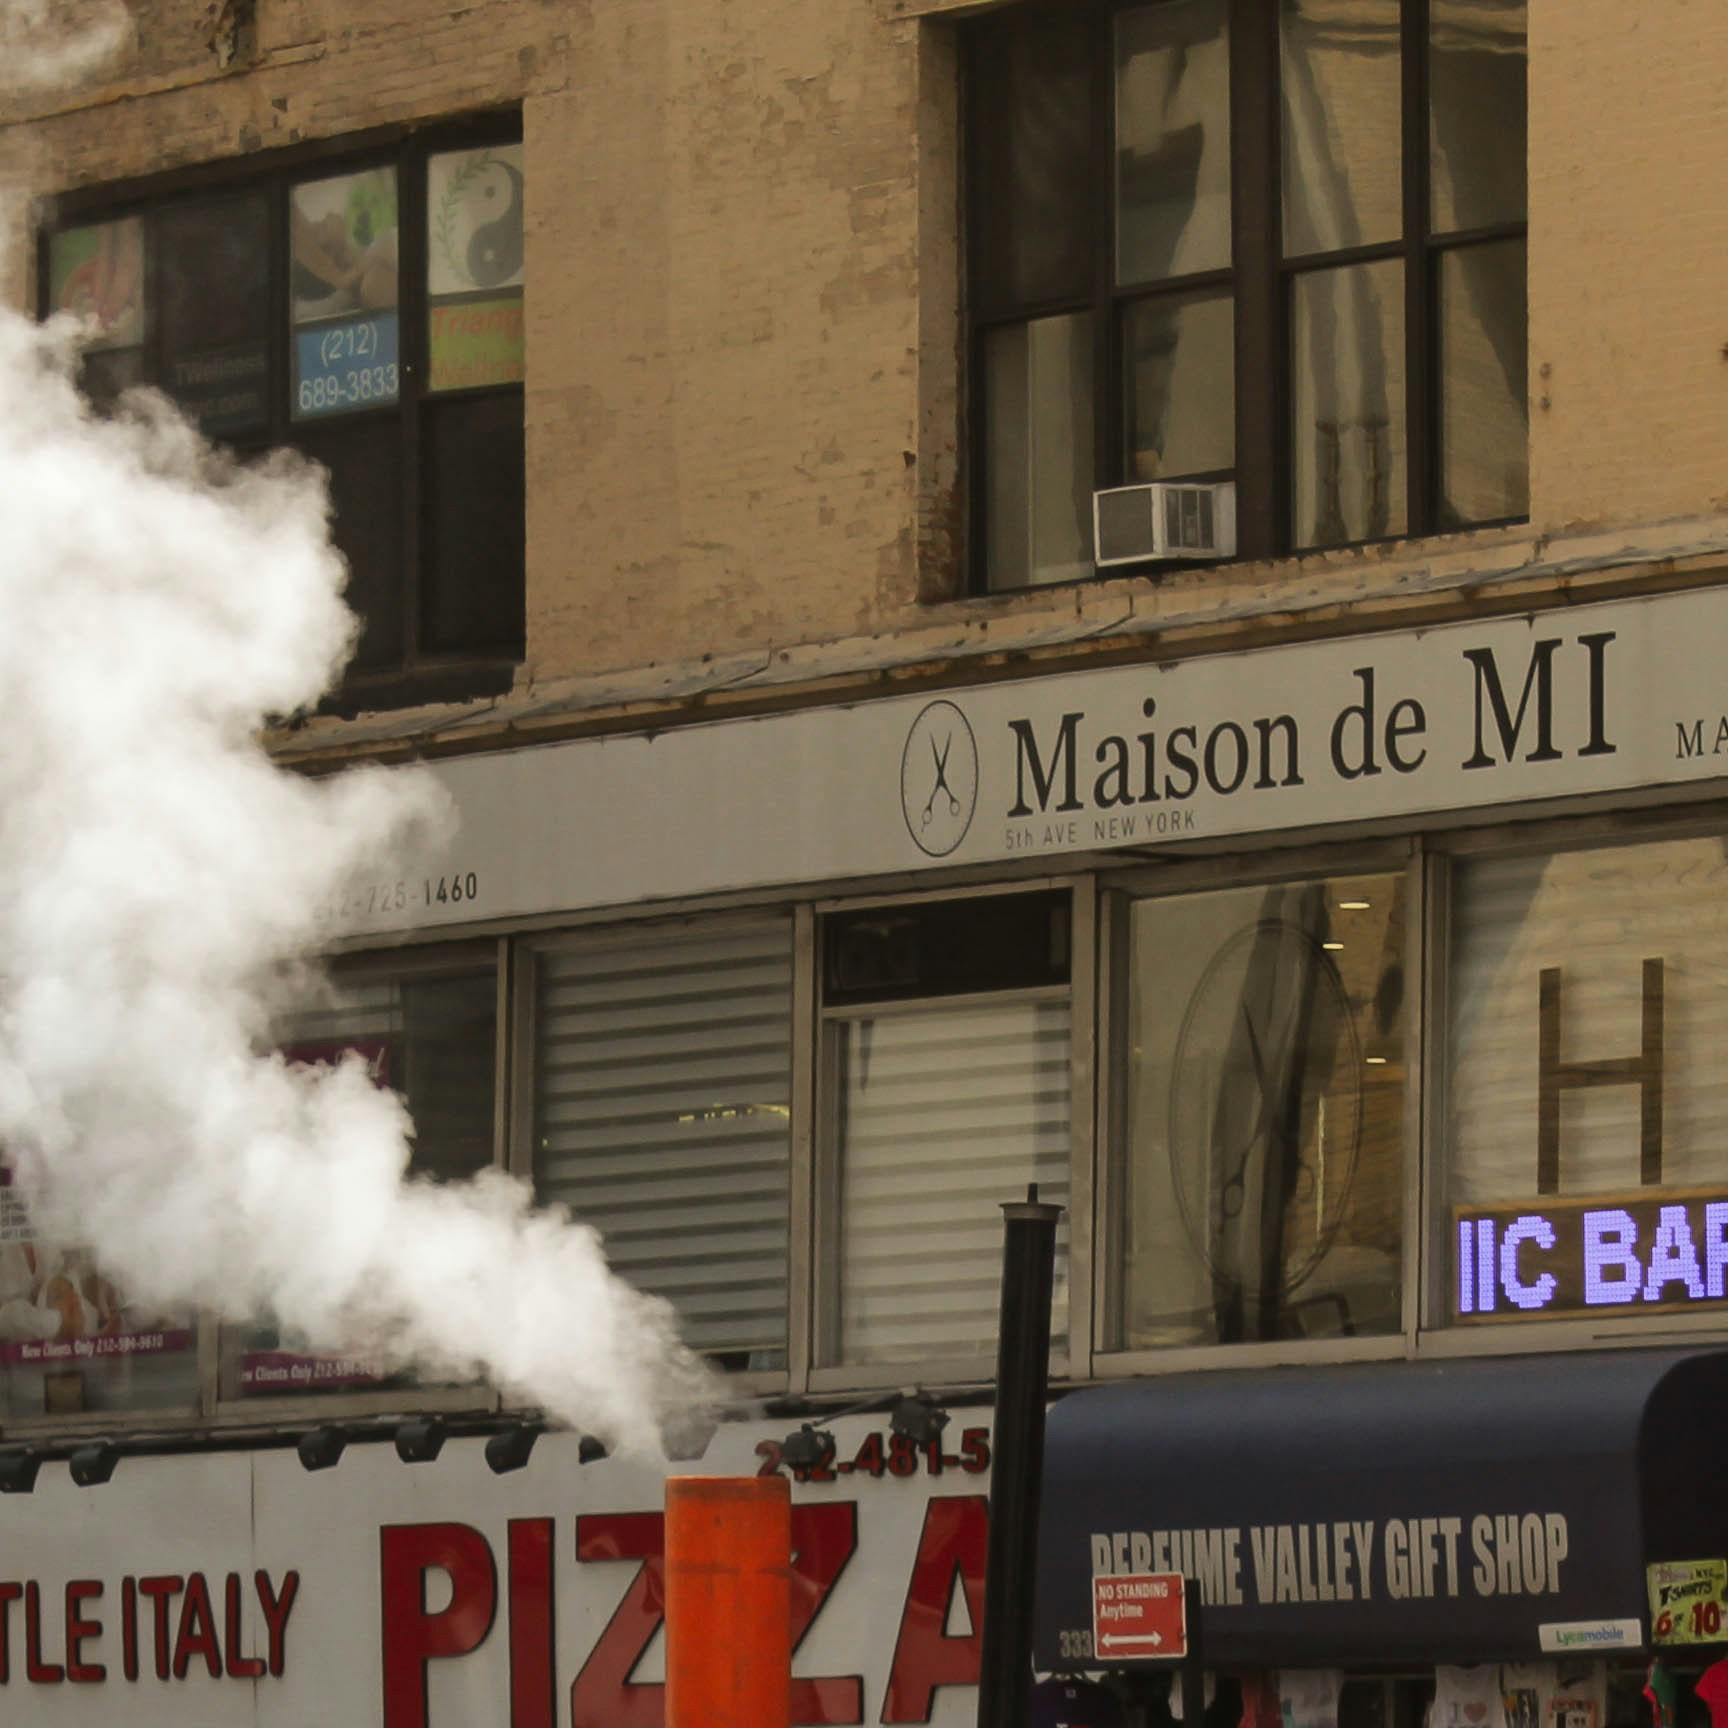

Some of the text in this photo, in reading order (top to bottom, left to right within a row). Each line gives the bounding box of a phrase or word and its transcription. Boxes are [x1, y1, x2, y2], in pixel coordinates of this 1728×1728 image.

[320, 322, 378, 366] (212)
[299, 364, 399, 410] 689-3833
[1006, 631, 1617, 818] Maison de MI
[1005, 809, 1197, 850] 5th AVE NEW YORK
[1537, 957, 1664, 1195] H
[1091, 1513, 1569, 1606] PERFUME VALLEY GIFT SHOP
[1099, 1581, 1169, 1601] NO STANDING
[1100, 1602, 1145, 1622] Anytime
[121, 1568, 300, 1683] ITALY
[1060, 1630, 1094, 1660] 333
[1555, 1626, 1624, 1646] Lycamobile
[1452, 1702, 1462, 1723] I
